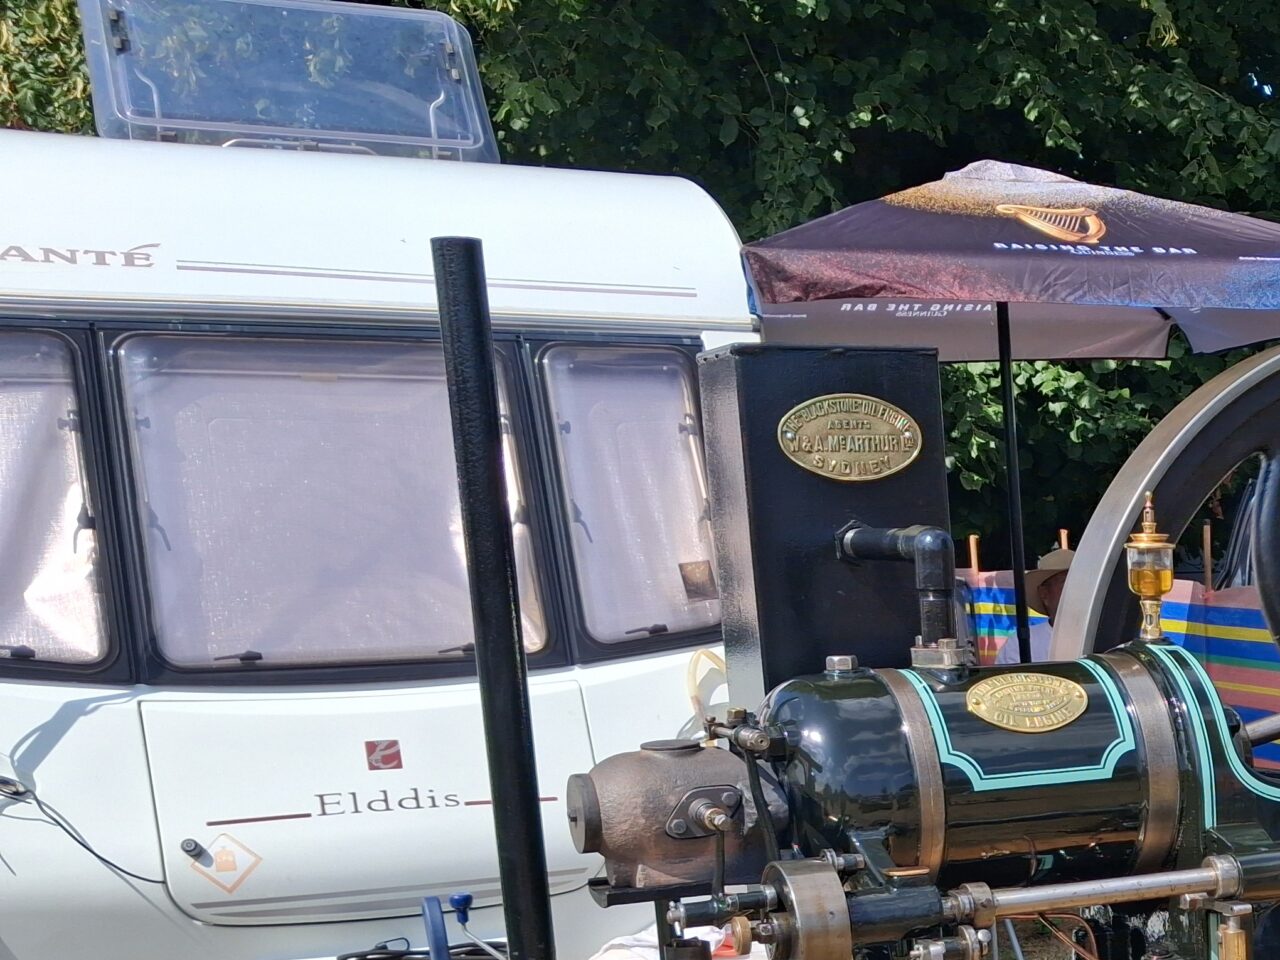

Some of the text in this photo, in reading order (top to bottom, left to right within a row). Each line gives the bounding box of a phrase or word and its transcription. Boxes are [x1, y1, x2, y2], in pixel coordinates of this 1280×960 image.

[0, 243, 161, 267] ANTÉ
[1099, 245, 1144, 253] THE
[813, 455, 892, 475] SYDNEY
[314, 788, 460, 817] Elddis
